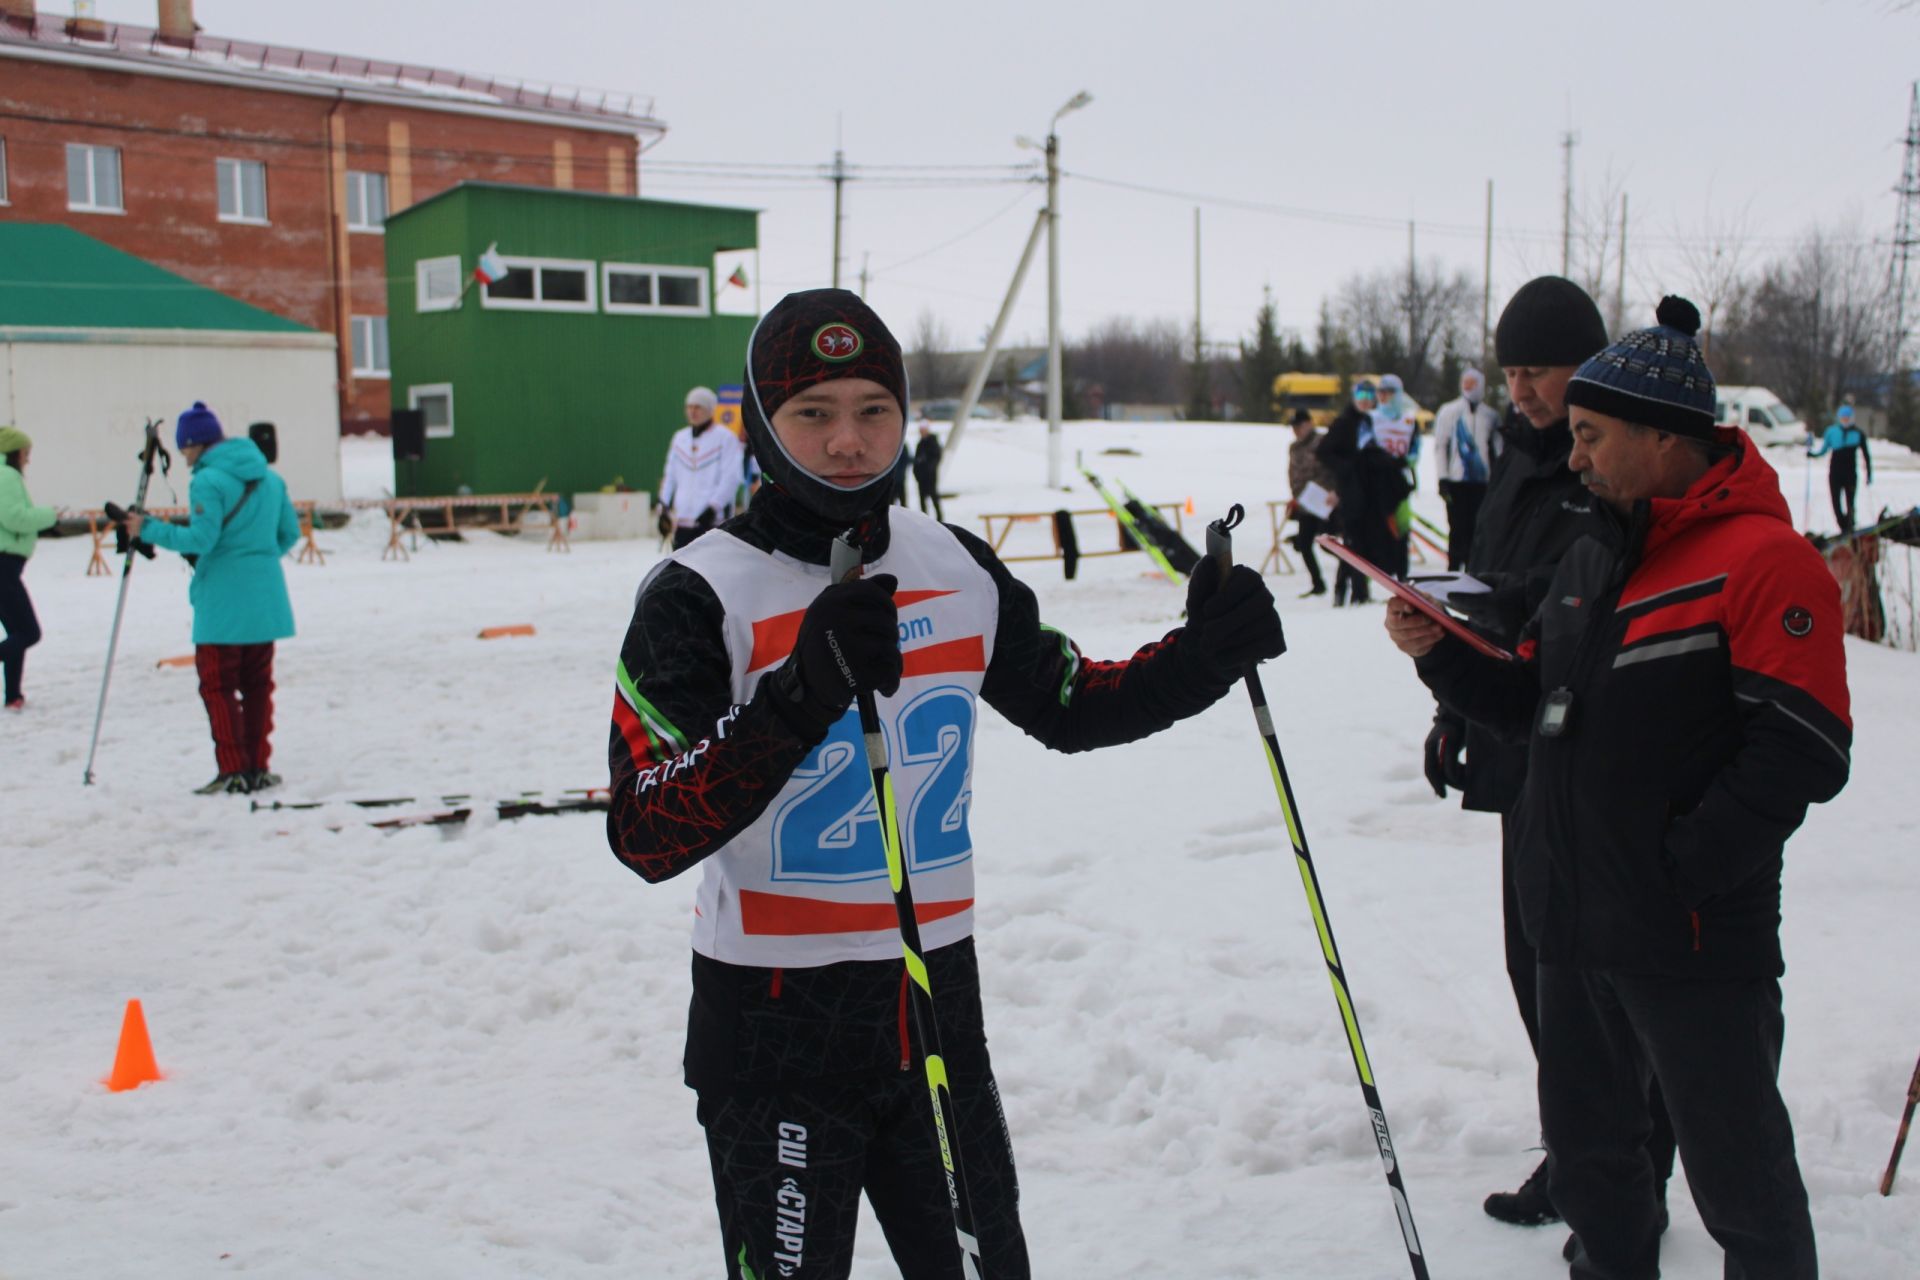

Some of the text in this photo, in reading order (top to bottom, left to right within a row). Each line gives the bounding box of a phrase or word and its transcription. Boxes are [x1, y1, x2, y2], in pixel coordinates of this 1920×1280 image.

[825, 629, 857, 688] NORDSKI
[770, 684, 977, 882] 22
[777, 1121, 808, 1168] СШ
[1372, 1110, 1393, 1158] RACE
